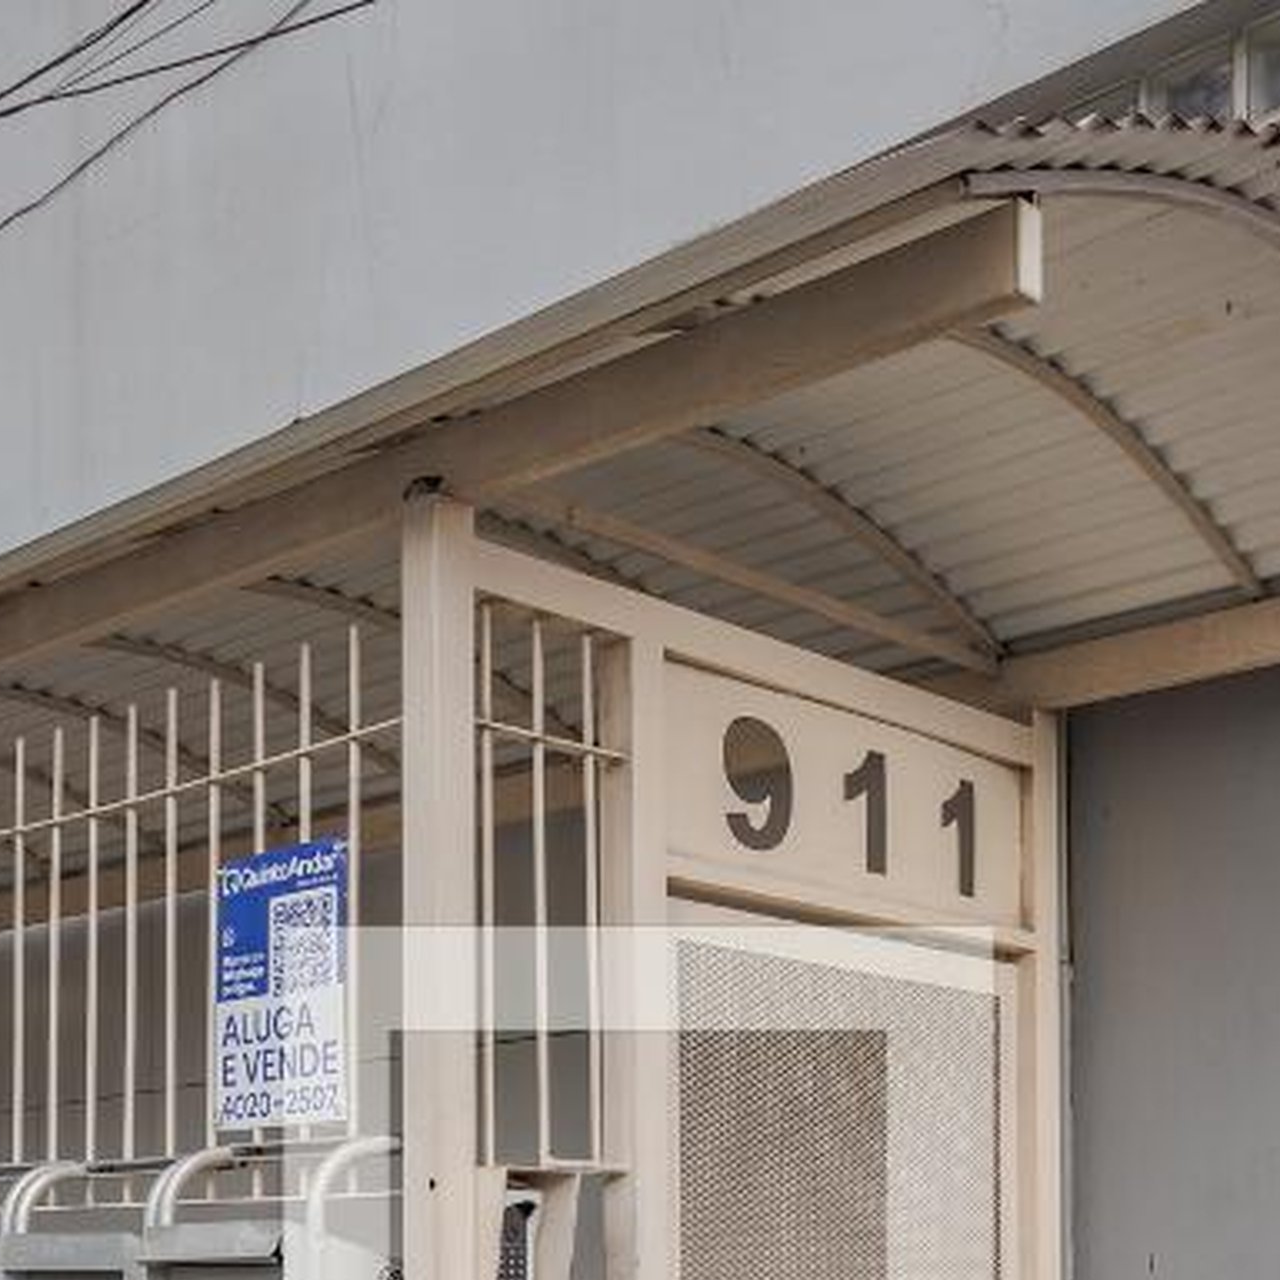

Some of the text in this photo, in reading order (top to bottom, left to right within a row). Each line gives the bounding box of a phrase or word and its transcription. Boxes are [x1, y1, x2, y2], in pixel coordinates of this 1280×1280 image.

[722, 715, 975, 898] 911
[222, 1002, 315, 1047] ALUGA
[222, 1039, 338, 1088] E VENDE
